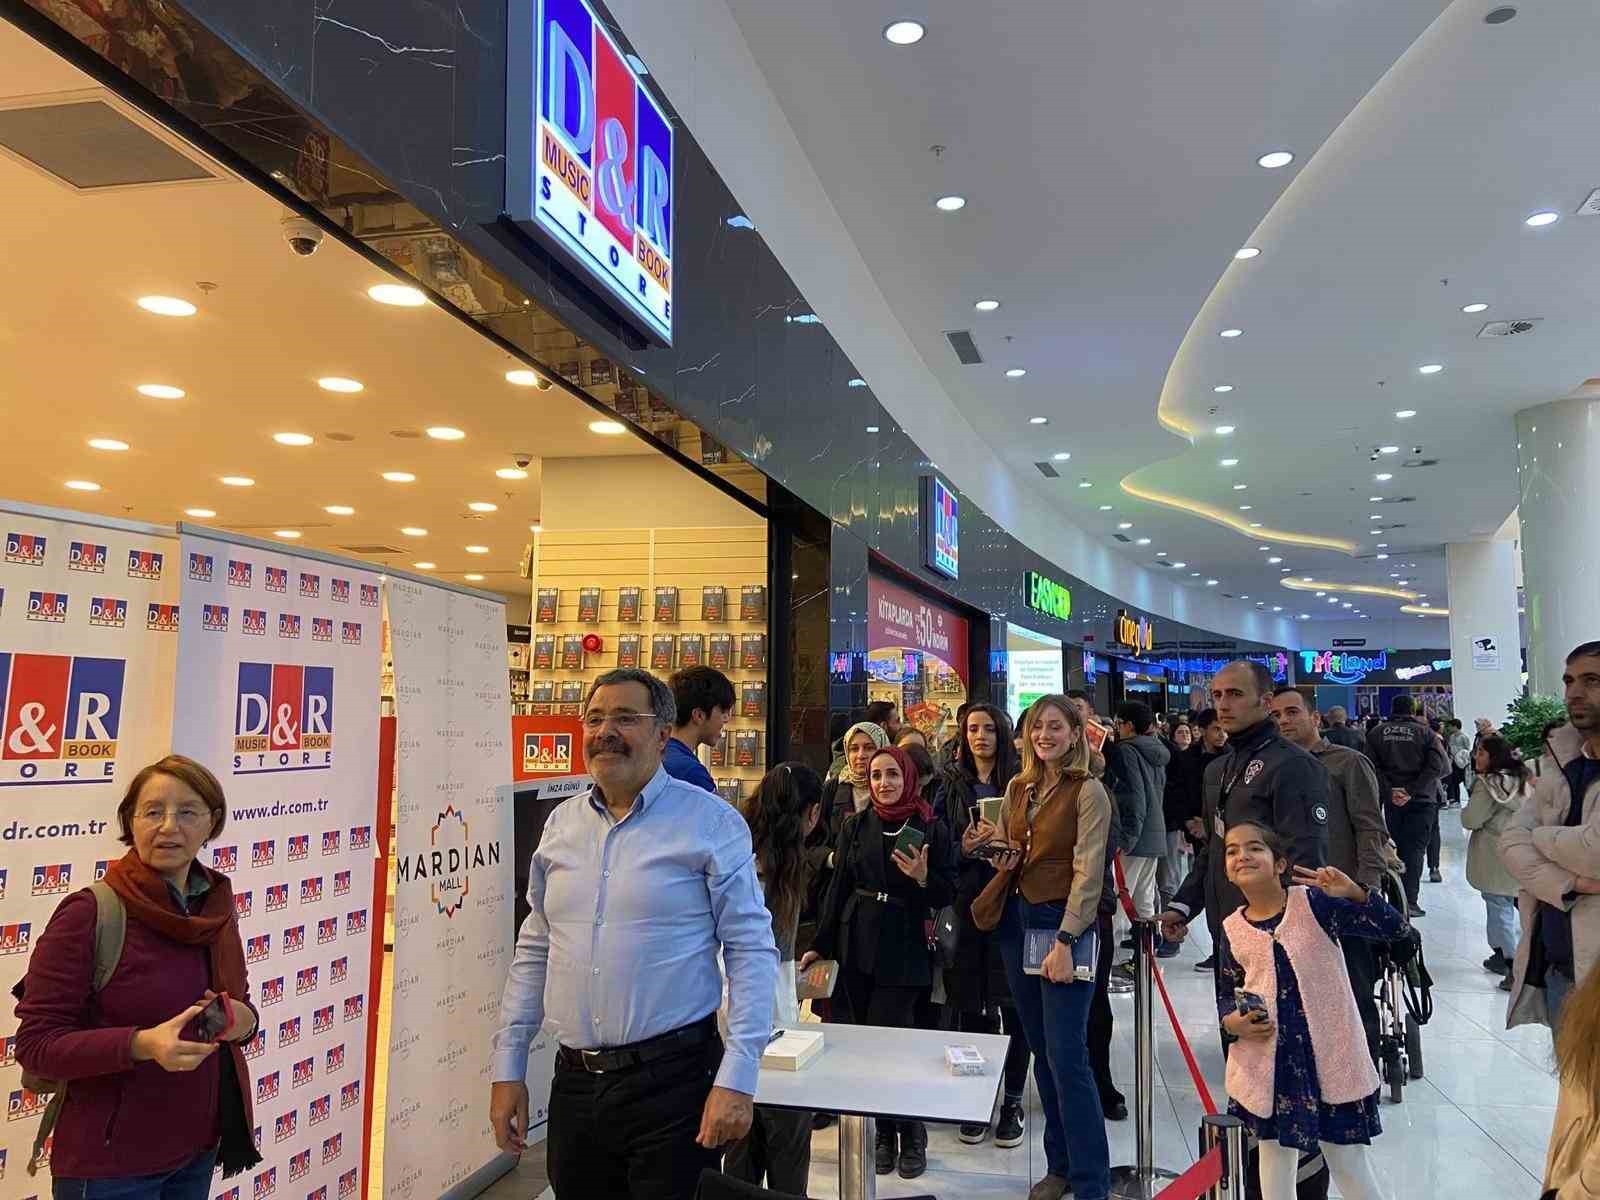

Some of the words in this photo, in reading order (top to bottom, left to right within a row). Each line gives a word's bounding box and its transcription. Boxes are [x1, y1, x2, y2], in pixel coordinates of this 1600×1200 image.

[549, 20, 670, 256] D&R
[545, 135, 590, 202] MUSIC
[637, 240, 669, 284] BOOK
[541, 176, 671, 319] STORE
[238, 693, 329, 747] D&R
[68, 743, 111, 757] BOOK
[236, 739, 267, 750] MUSIC
[303, 736, 330, 747] BOOK
[526, 744, 568, 763] D&R
[233, 751, 331, 768] STORE
[232, 798, 330, 821] www.dr.com.tr
[397, 841, 501, 885] MARDIAN
[439, 877, 463, 892] MALL
